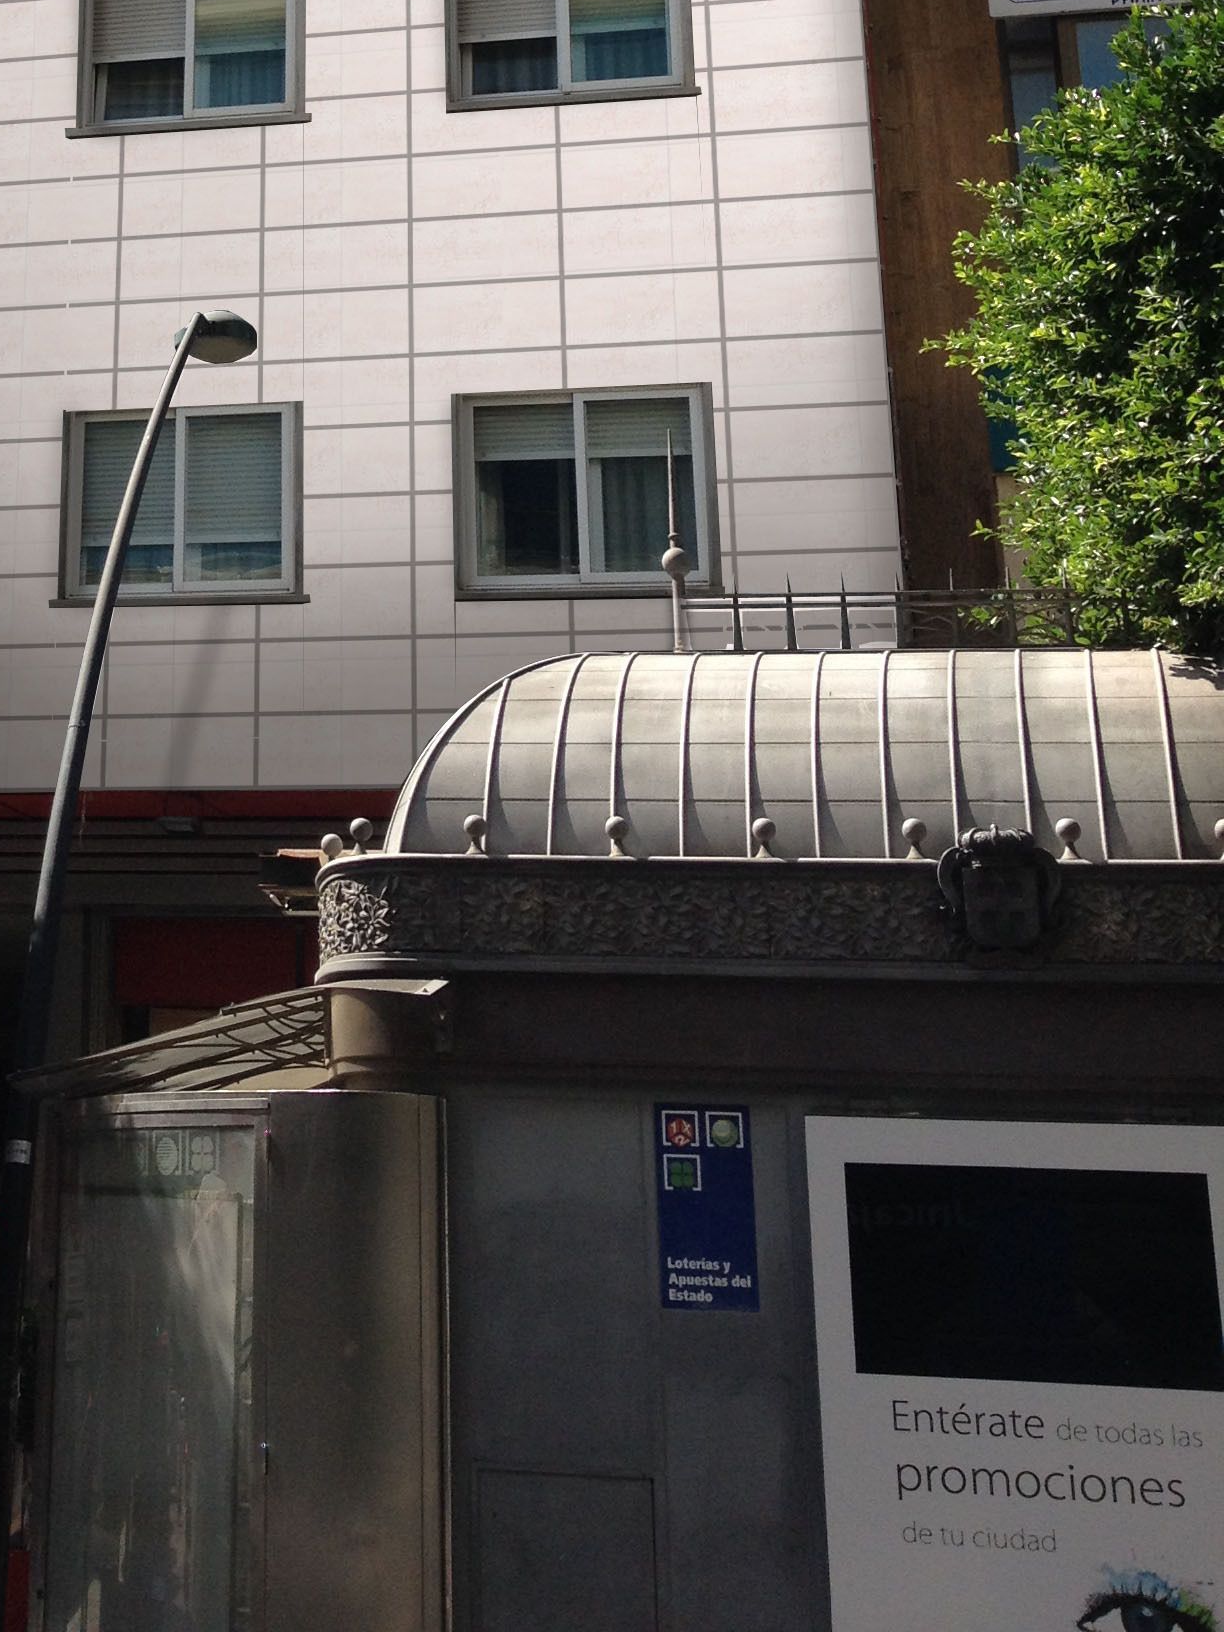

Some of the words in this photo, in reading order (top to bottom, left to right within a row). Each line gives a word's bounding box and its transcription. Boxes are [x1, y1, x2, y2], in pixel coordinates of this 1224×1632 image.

[722, 1261, 731, 1274] y
[668, 1272, 728, 1288] Apuestas
[731, 1274, 752, 1288] del
[668, 1288, 713, 1303] Estado
[892, 1400, 1045, 1440] Entérate
[1056, 1419, 1088, 1442] de
[1096, 1422, 1164, 1447] todas
[1172, 1423, 1203, 1448] las
[896, 1462, 1186, 1508] promociones
[902, 1521, 933, 1545] de
[940, 1526, 965, 1547] tu
[972, 1528, 1058, 1553] ciudad
